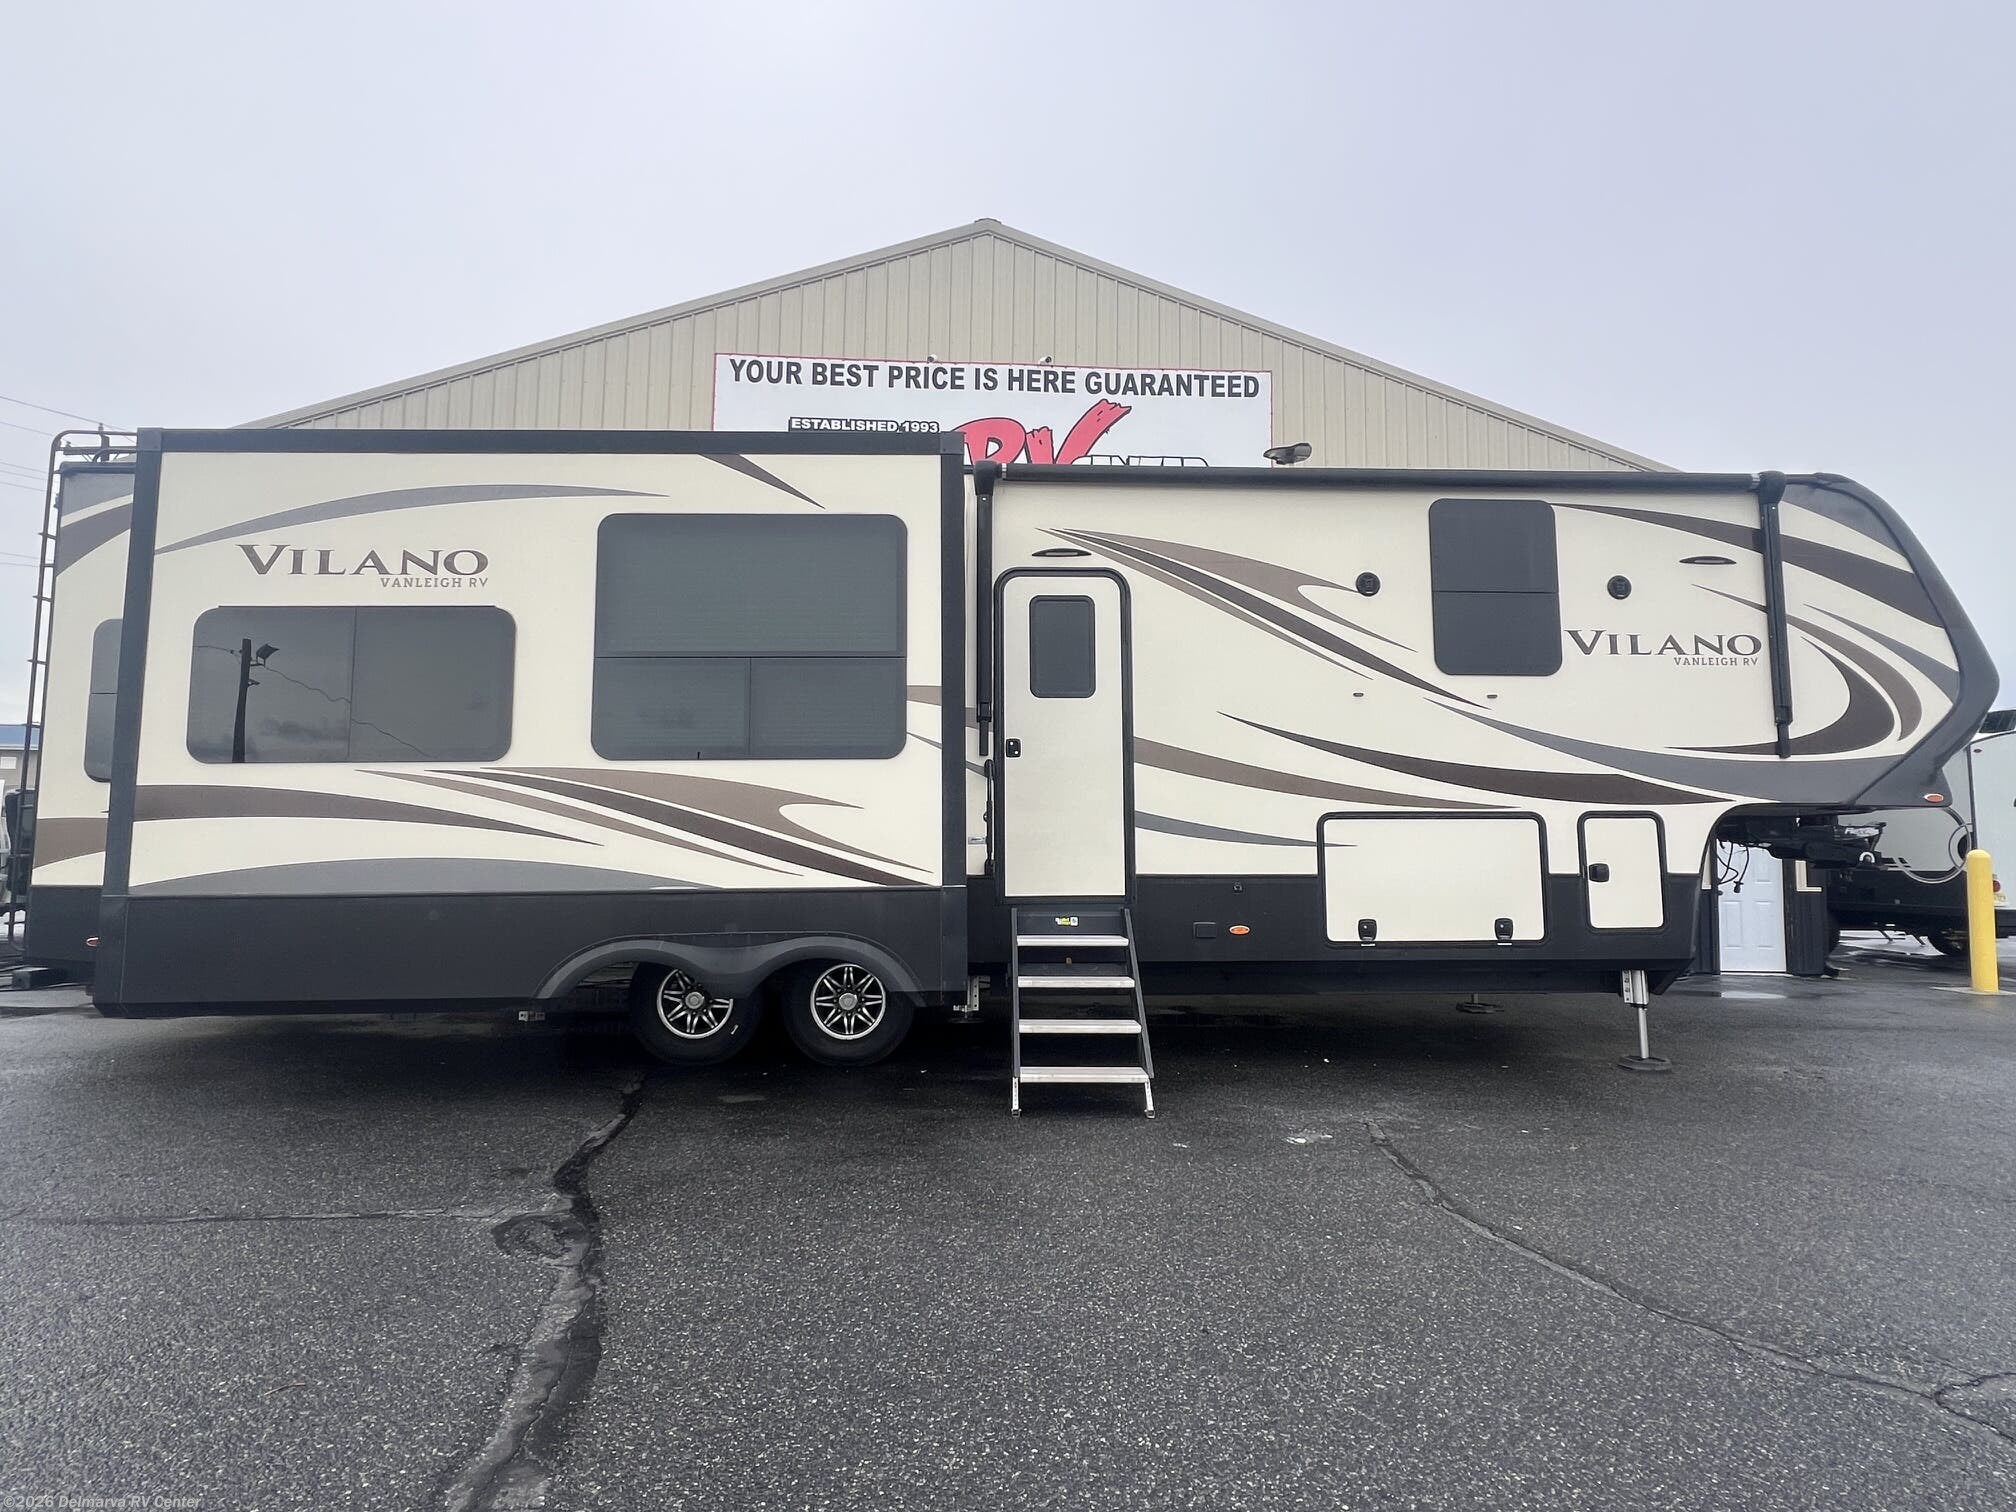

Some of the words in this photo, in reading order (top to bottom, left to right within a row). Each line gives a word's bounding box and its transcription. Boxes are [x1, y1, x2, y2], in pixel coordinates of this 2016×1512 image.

[729, 358, 802, 385] YOUR
[812, 362, 879, 387] BEST
[888, 365, 965, 390] PRICE
[974, 367, 998, 391] IS
[1008, 368, 1076, 394] HERE
[1085, 371, 1260, 398] GUARANTEED
[790, 418, 898, 432] ESTABLISHED
[901, 421, 939, 433] 1993
[236, 544, 489, 576] VILANO
[380, 577, 462, 588] VANLEIGH
[468, 577, 489, 588] RV
[1564, 630, 1762, 656] VILANO
[1674, 657, 1738, 666] VANLEIGH
[1743, 657, 1759, 666] RV
